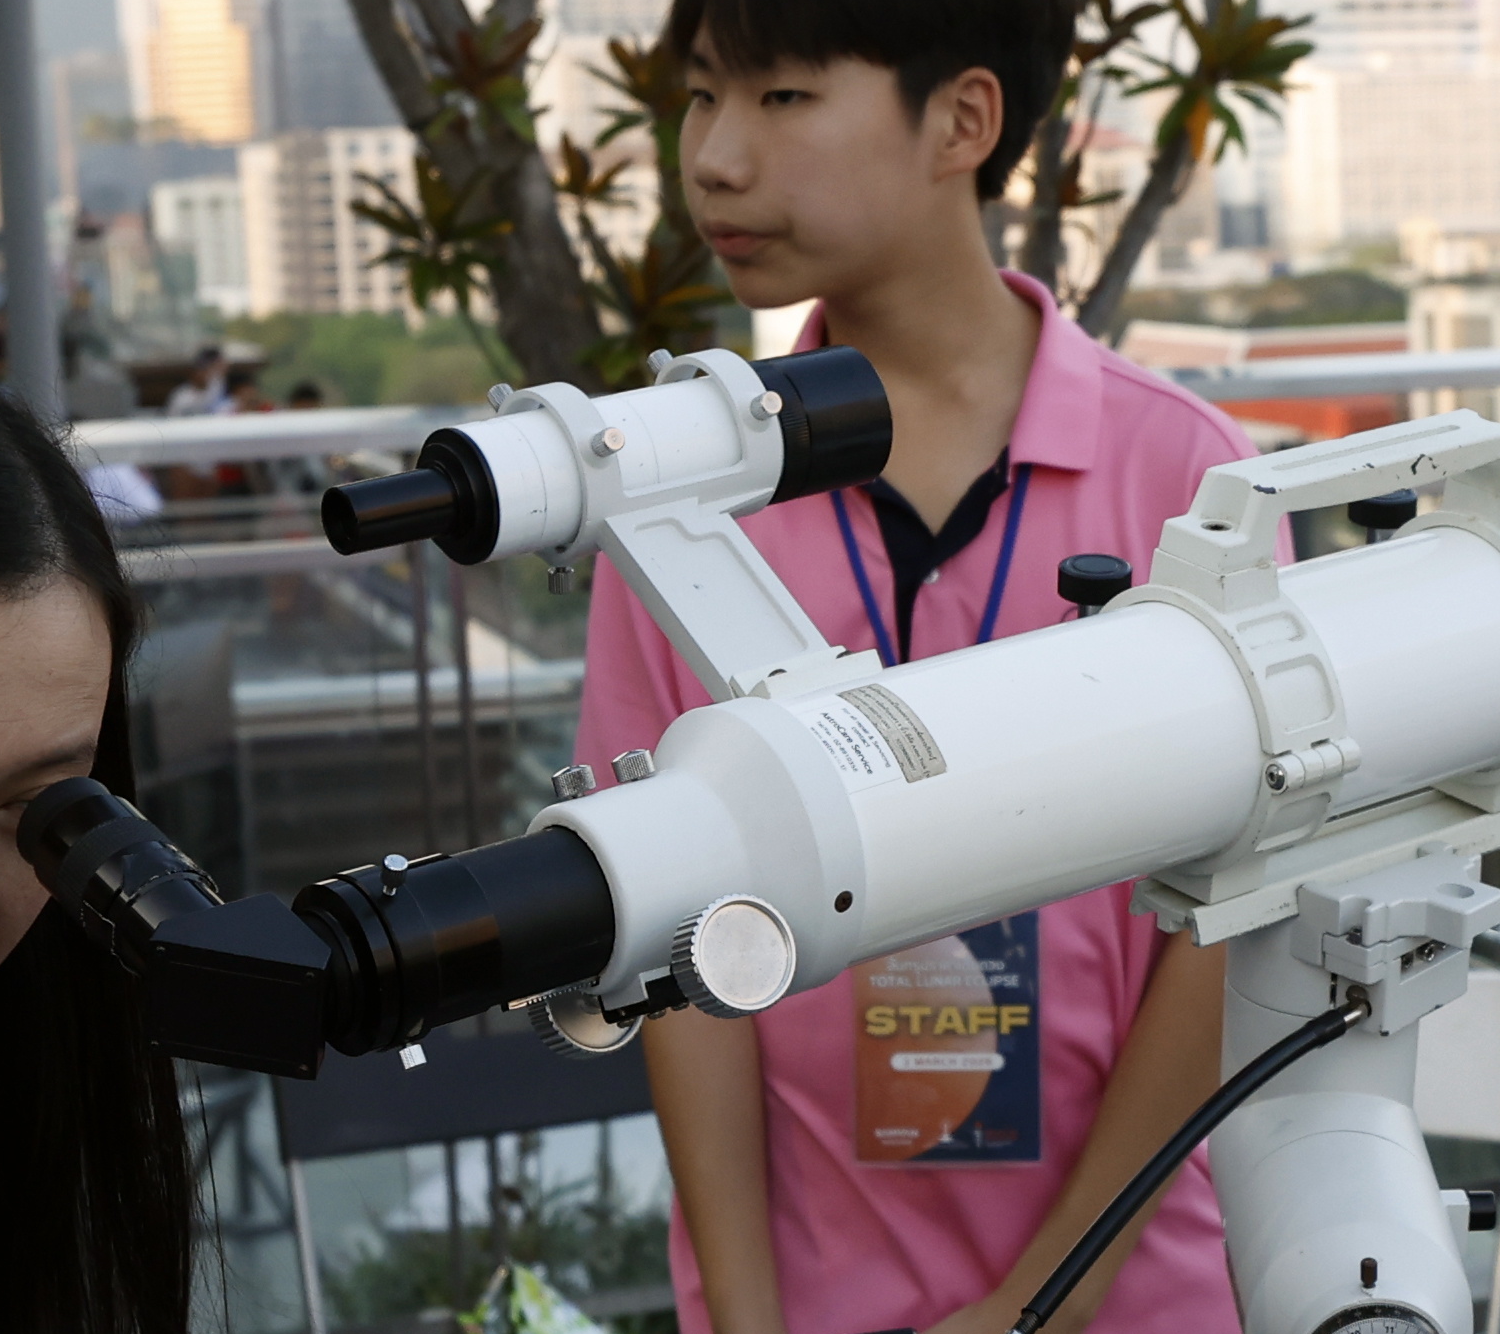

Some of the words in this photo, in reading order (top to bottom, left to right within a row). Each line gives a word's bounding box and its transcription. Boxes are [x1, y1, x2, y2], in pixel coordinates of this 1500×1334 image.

[820, 712, 853, 743] AstroCare
[851, 743, 873, 774] Service
[865, 1005, 1031, 1036] STAFF
[1385, 1326, 1395, 1334] 11
